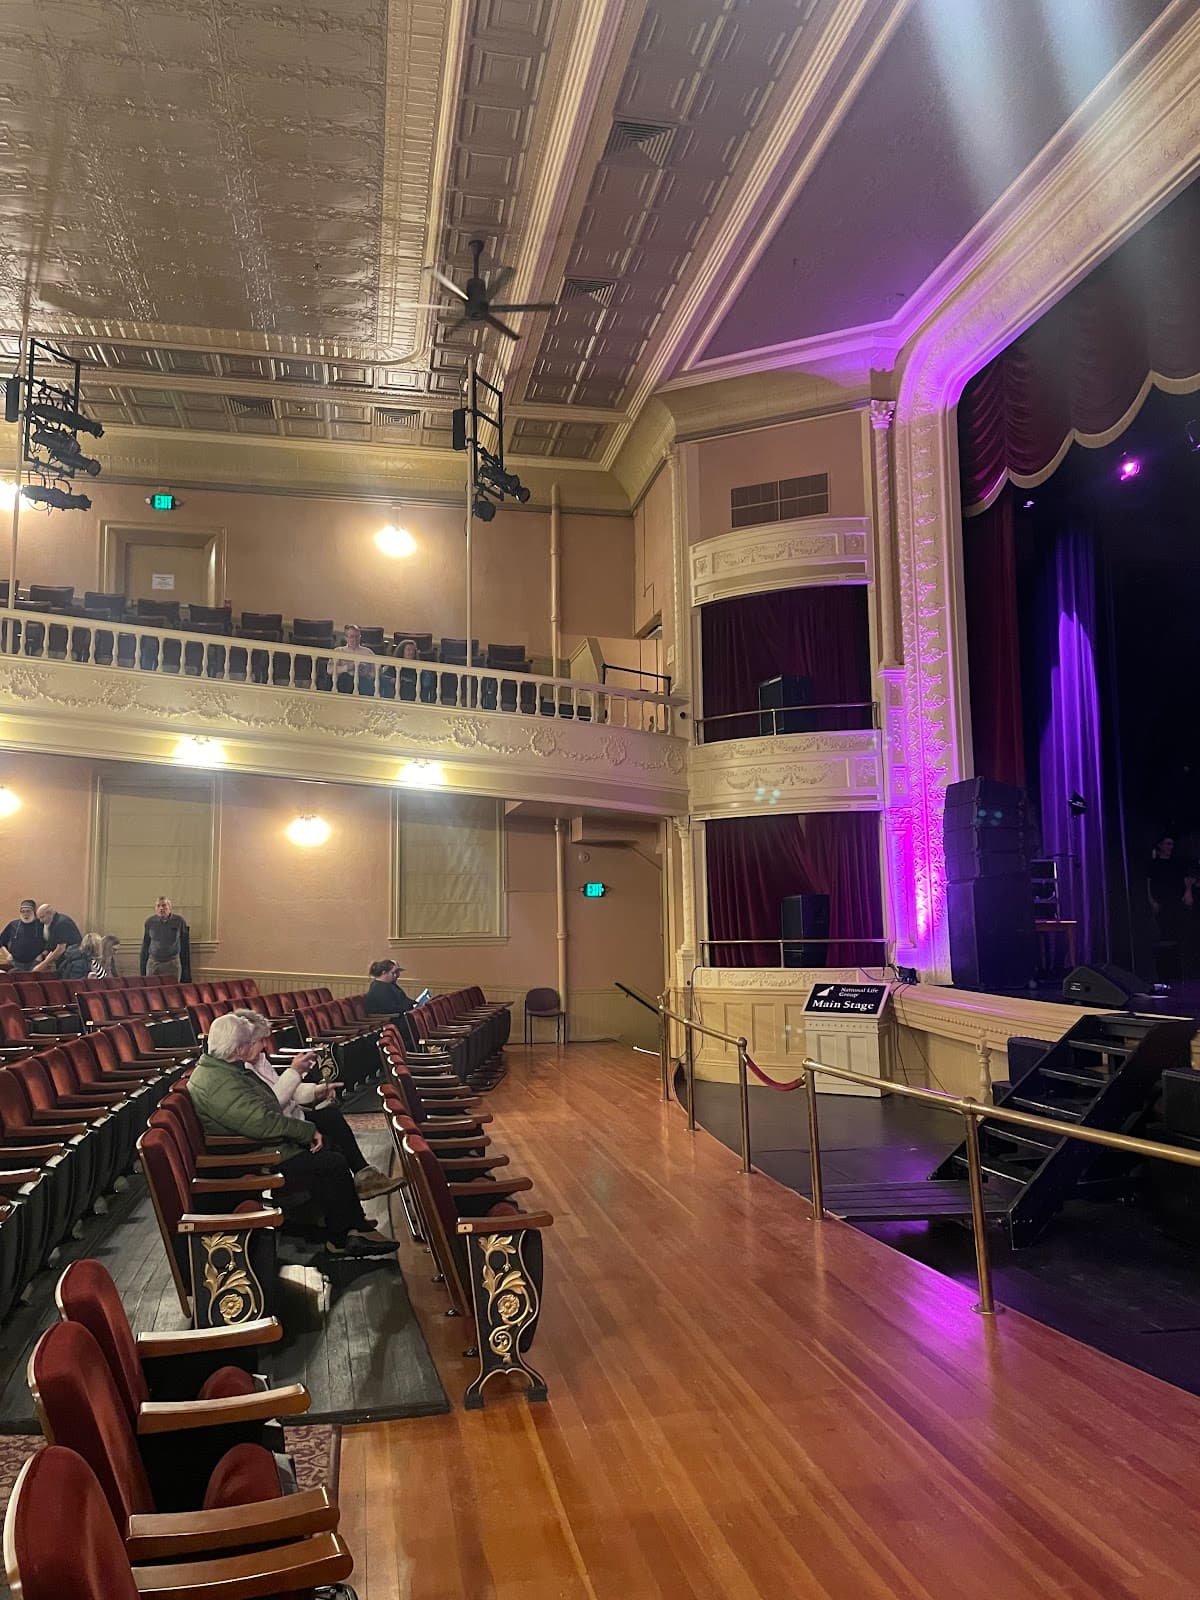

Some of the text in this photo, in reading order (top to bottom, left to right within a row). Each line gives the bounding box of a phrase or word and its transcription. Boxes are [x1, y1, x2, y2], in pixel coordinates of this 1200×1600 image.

[155, 496, 173, 509] EXIT
[812, 999, 875, 1011] Main Stage
